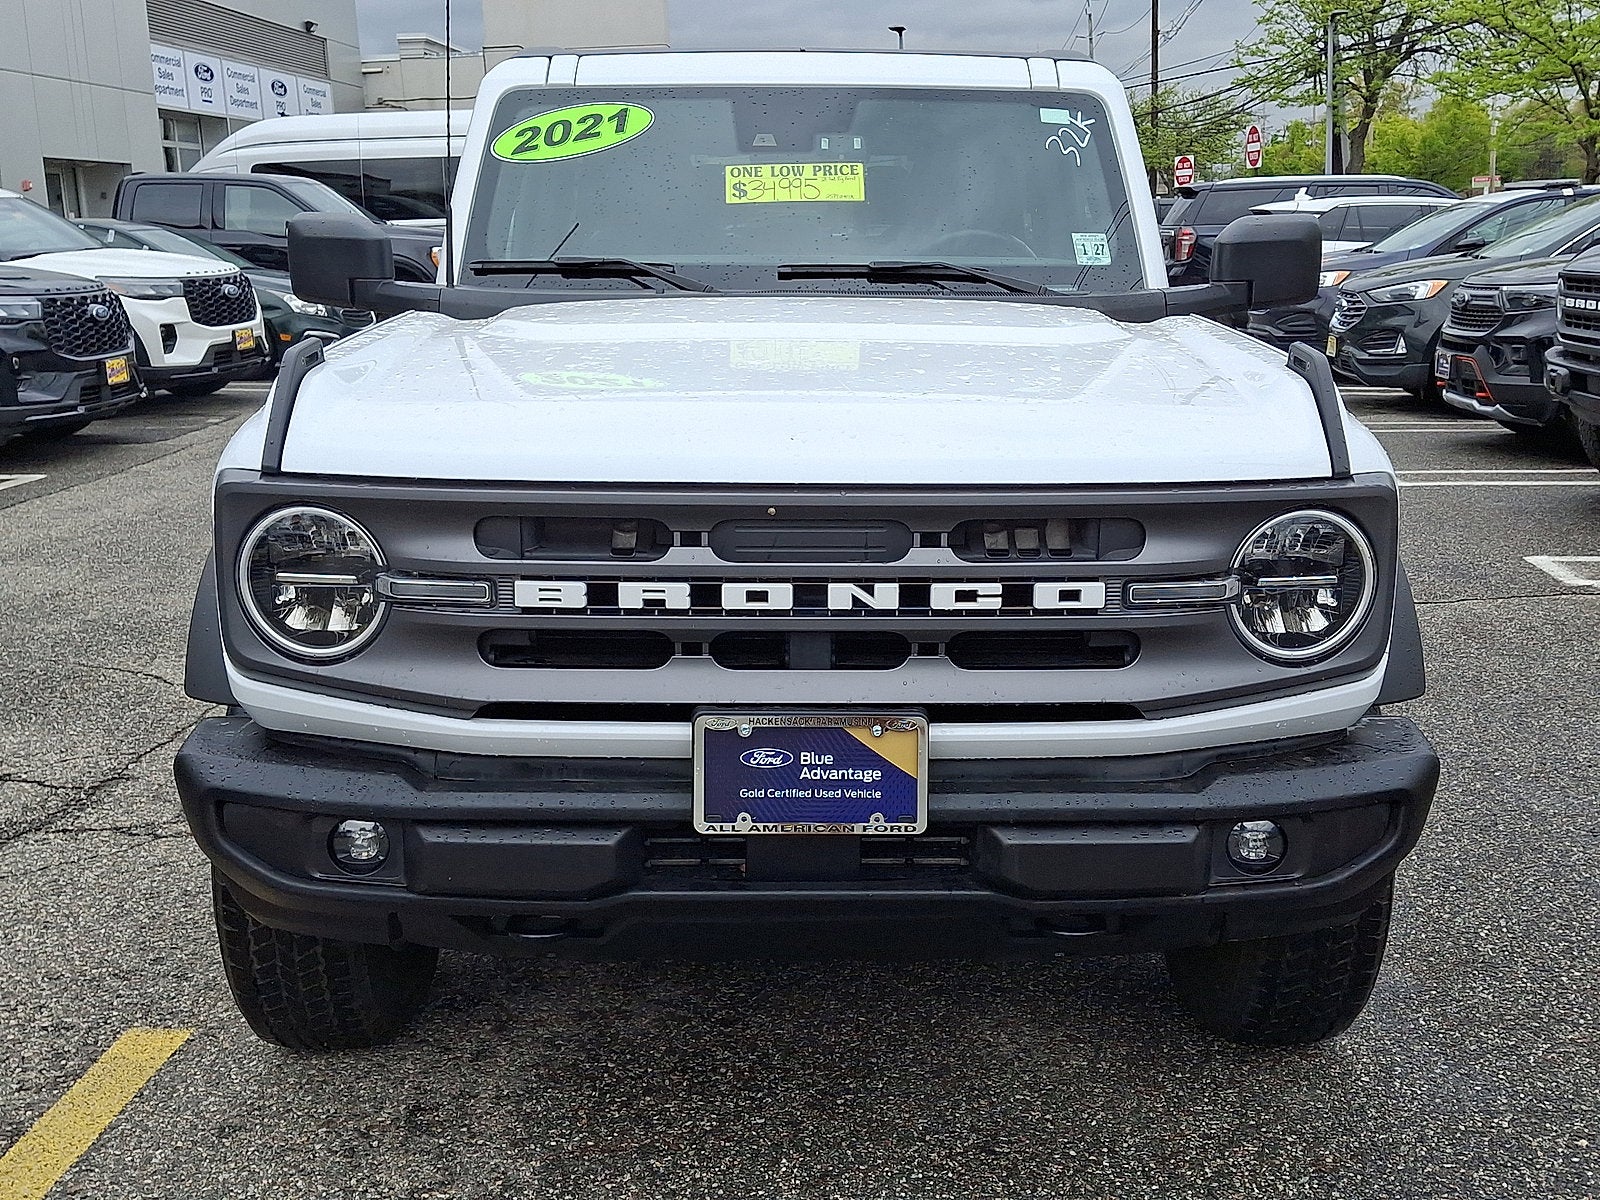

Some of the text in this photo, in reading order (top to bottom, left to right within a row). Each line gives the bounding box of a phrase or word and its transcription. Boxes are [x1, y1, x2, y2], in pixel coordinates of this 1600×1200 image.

[158, 67, 174, 81] Sales
[226, 67, 256, 83] Commercial
[201, 86, 213, 98] PRO
[235, 82, 250, 95] Sales
[229, 94, 259, 110] Department
[511, 107, 630, 156] 2021
[730, 164, 860, 178] ONE LOW PRICE
[1080, 242, 1105, 256] 1 27
[1565, 297, 1600, 310] BRO
[514, 580, 1106, 611] BRONCO
[749, 750, 784, 765] Ford
[800, 751, 834, 765] Blue
[799, 766, 882, 782] Advantage
[739, 788, 882, 799] Gold Certified Used Vehicle
[704, 824, 918, 833] ALL AMERICAN FORD
